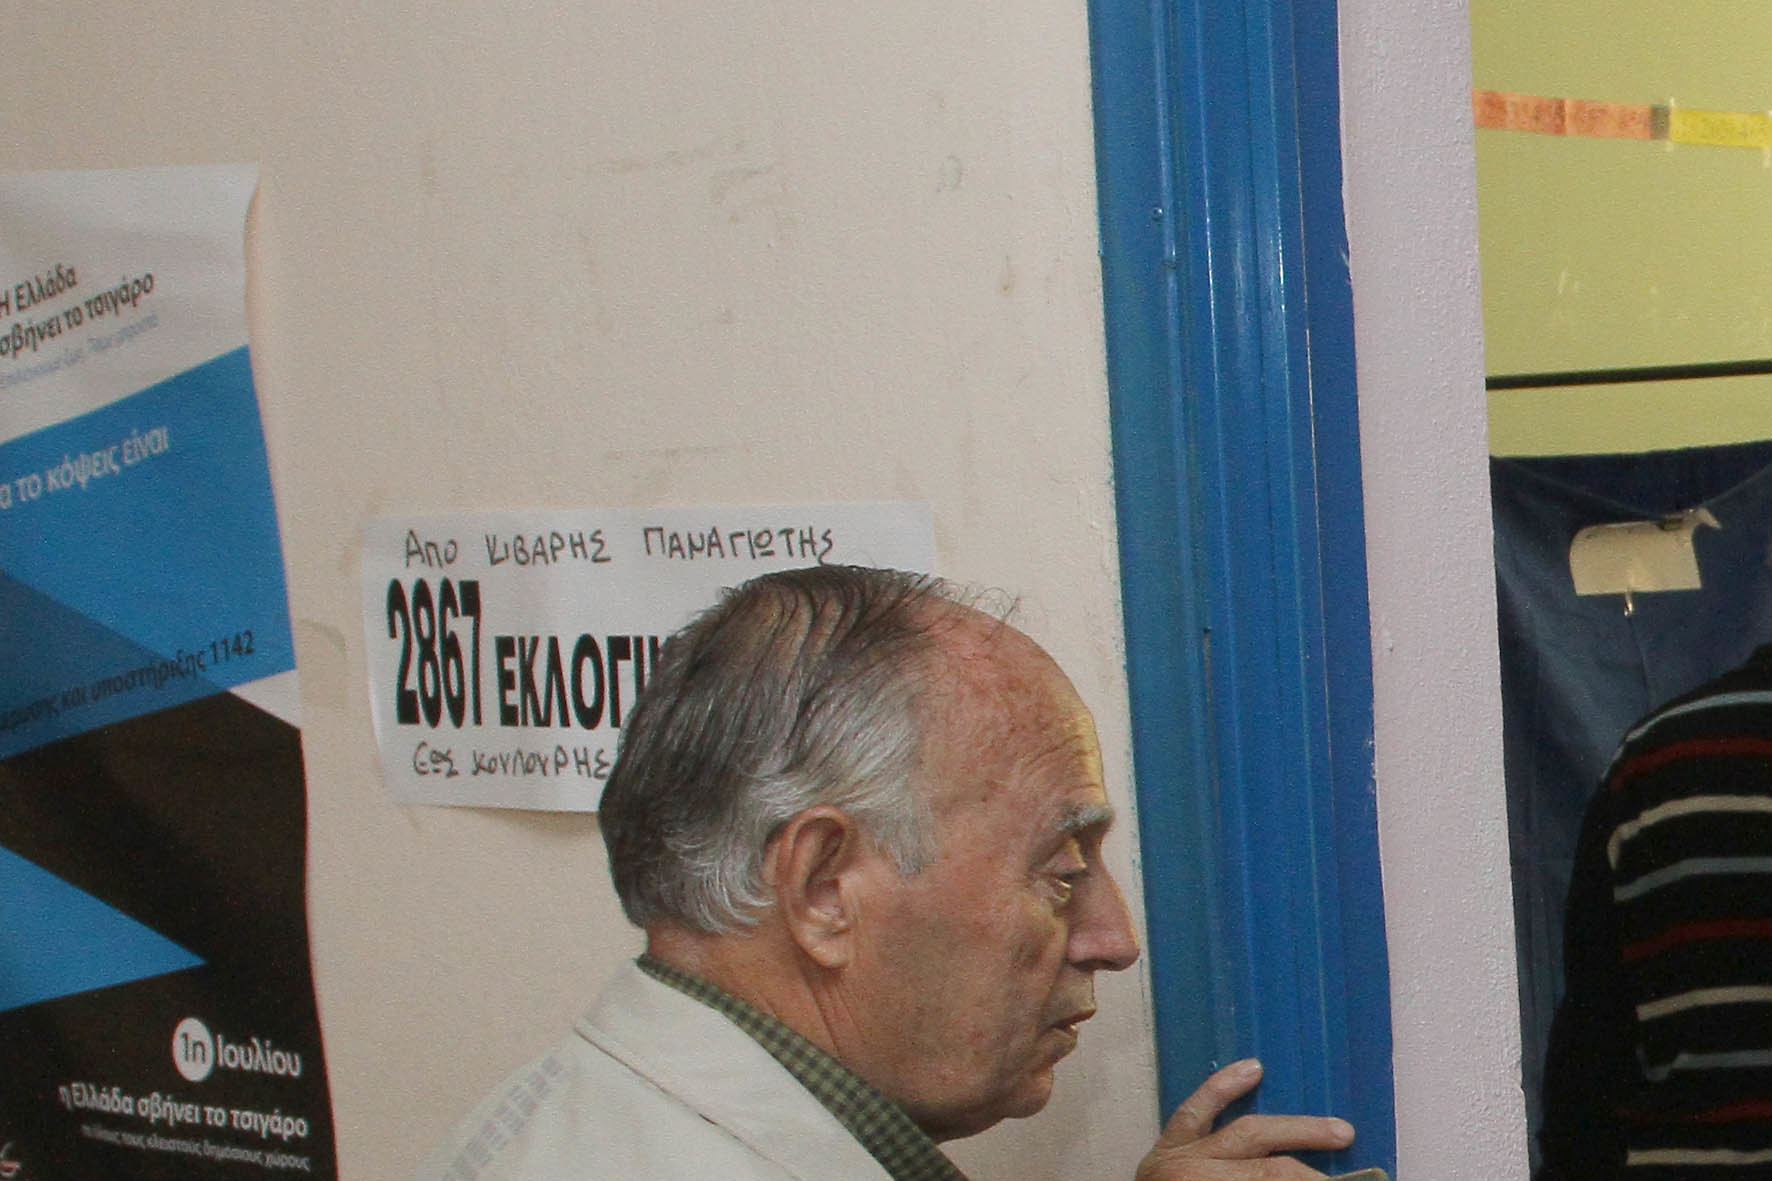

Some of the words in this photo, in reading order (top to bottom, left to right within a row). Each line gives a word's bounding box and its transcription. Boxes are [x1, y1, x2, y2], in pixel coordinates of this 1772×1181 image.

[15, 262, 78, 312] Ελλάδα
[62, 305, 83, 330] το
[85, 272, 155, 320] τσιγάρο
[16, 472, 42, 502] το
[46, 445, 121, 491] κόψεις
[121, 424, 170, 465] είναι
[210, 628, 255, 665] 1142
[386, 576, 482, 729] 2867
[494, 632, 661, 731] ΕΚΛΟΓΙ
[216, 1034, 303, 1078] Ιουλίου
[72, 1081, 135, 1116] Ελλάδα
[136, 1091, 200, 1127] σβήνει
[204, 1105, 227, 1128] το
[230, 1108, 309, 1141] τσιγάρο
